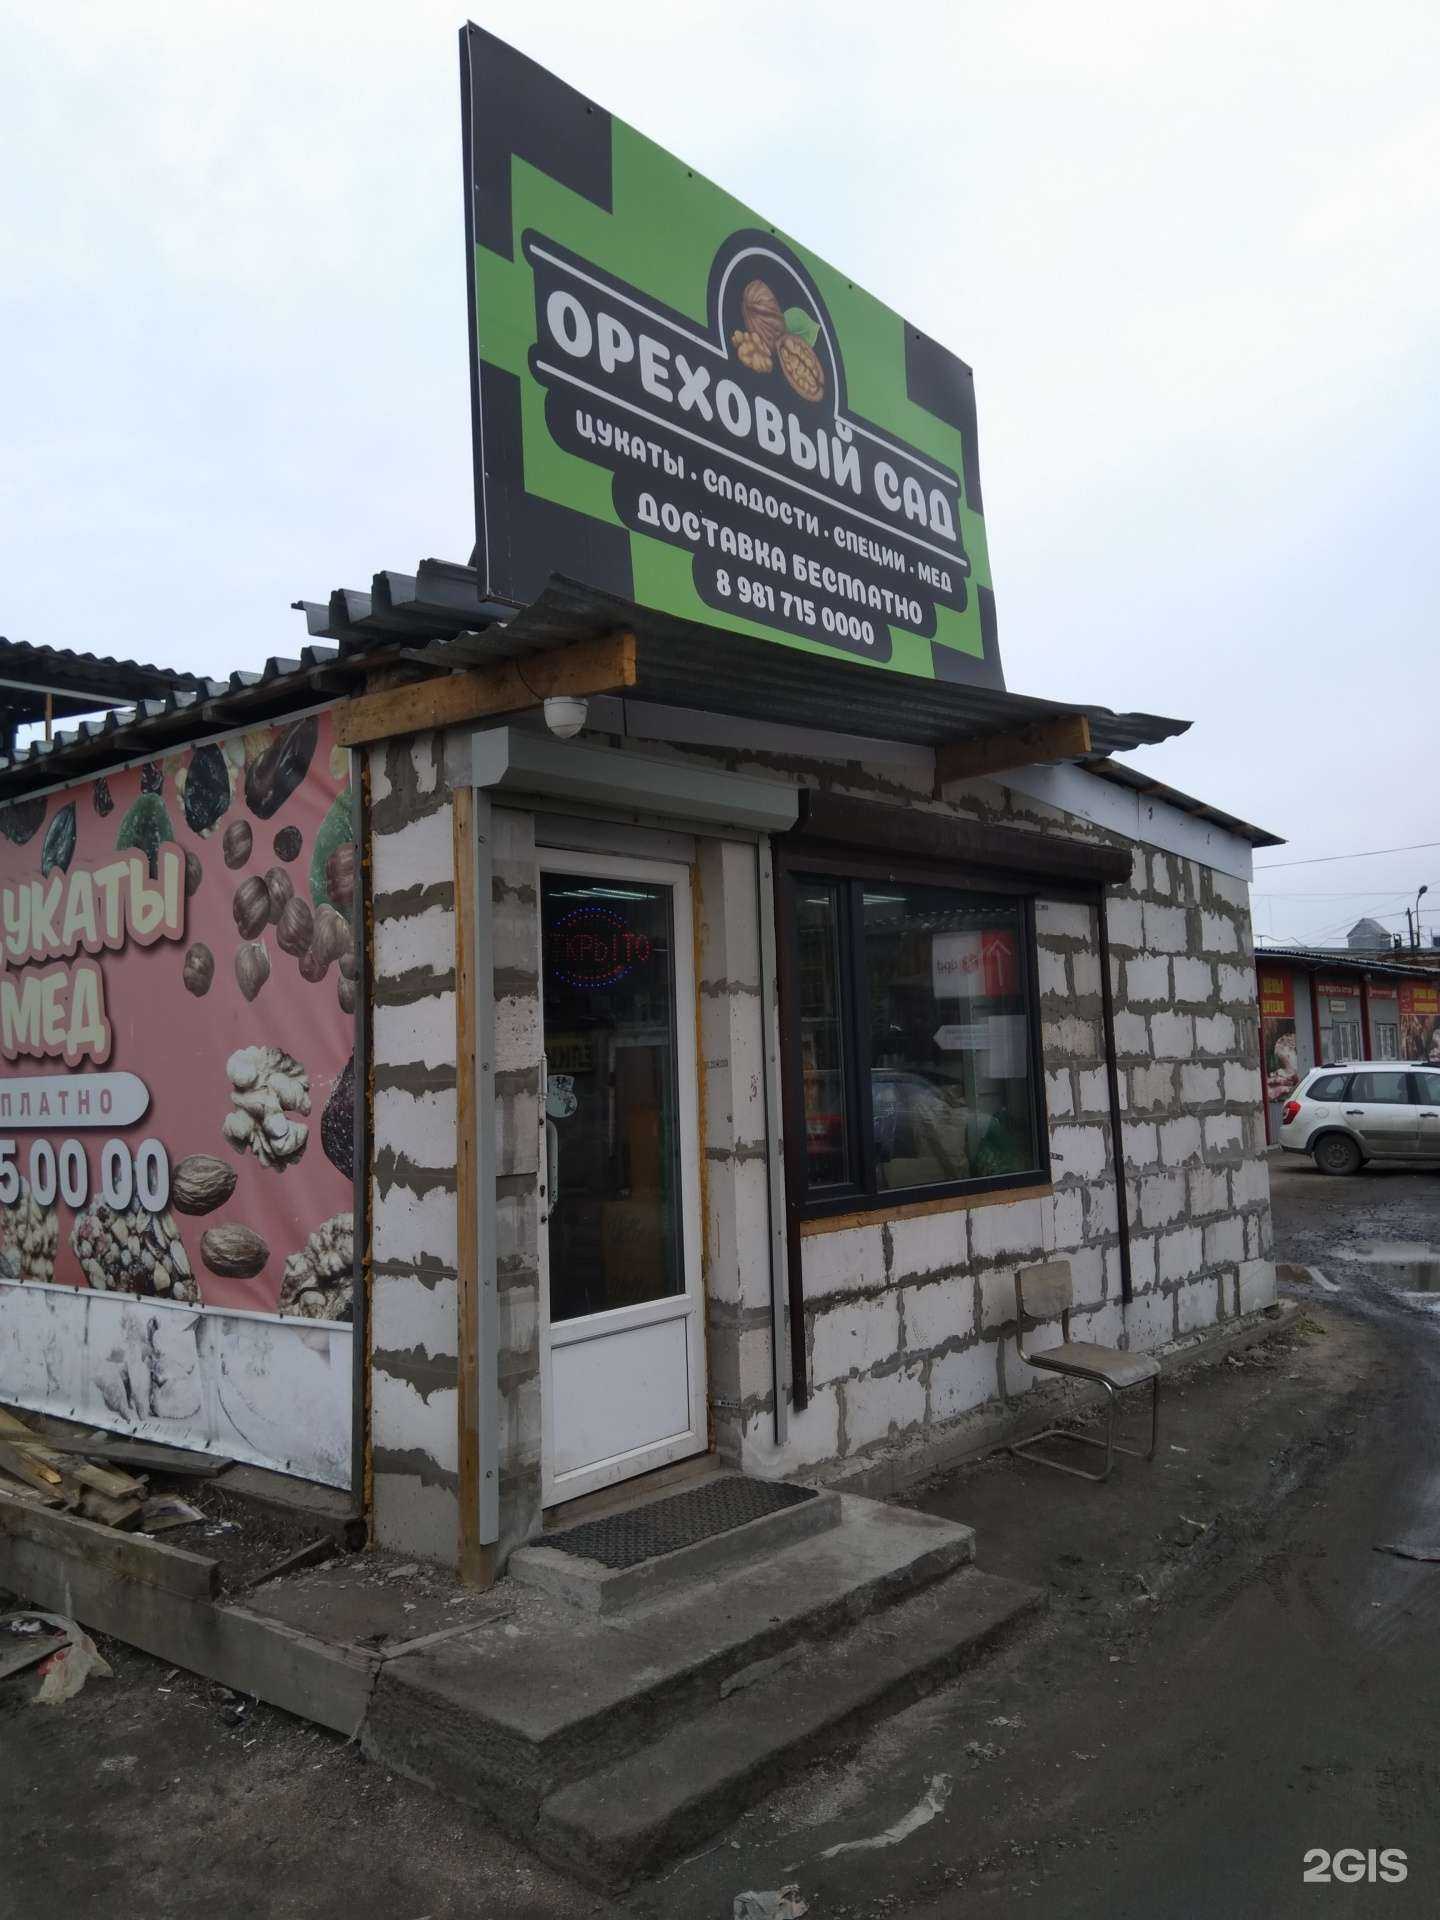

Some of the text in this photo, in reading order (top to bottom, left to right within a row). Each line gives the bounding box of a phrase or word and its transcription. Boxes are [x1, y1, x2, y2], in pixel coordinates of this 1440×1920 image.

[546, 290, 956, 541] ОРЕХОВЫЙ САД
[576, 409, 952, 593] ЦУКАТЫ СЛАДОСТИ СПЕЦИИ МЕД
[637, 492, 923, 625] ДОСТАВКА БЕСПЛАТНО
[716, 568, 875, 645] 8 981 715 0000
[0, 852, 179, 956] УКАТЫ
[0, 968, 106, 1056] МЕД
